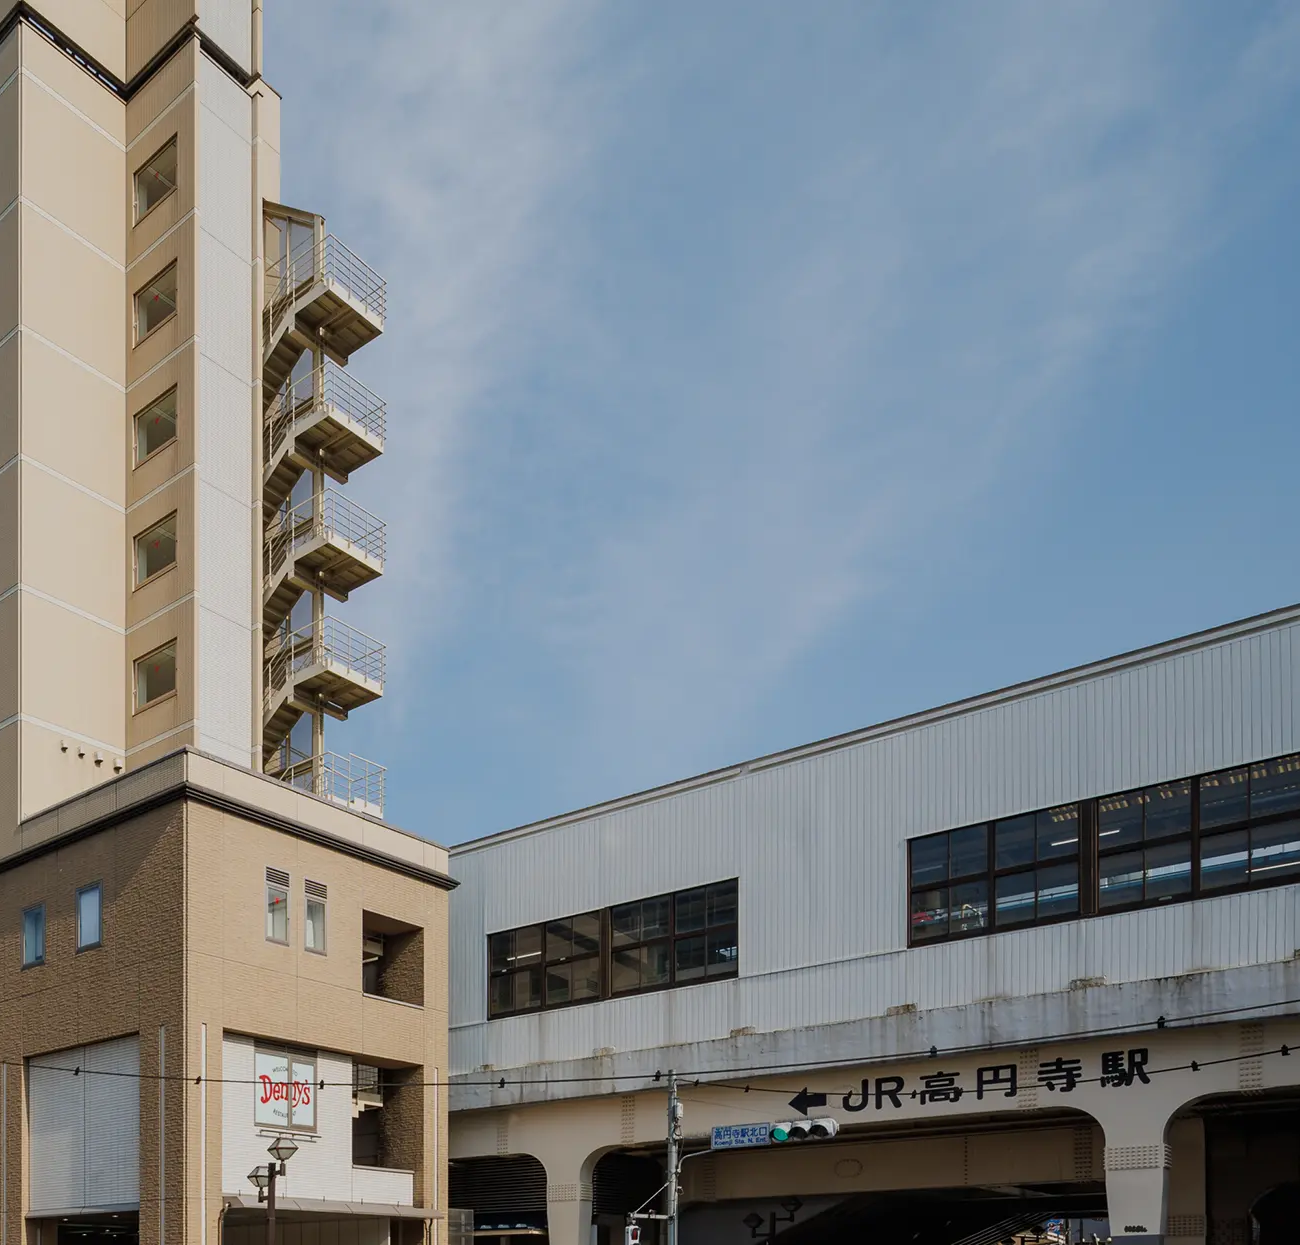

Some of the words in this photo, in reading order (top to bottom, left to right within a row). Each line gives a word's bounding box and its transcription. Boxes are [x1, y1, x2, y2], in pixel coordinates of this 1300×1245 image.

[259, 1075, 310, 1108] Denny's
[715, 1126, 768, 1140] 高円寺駅北口
